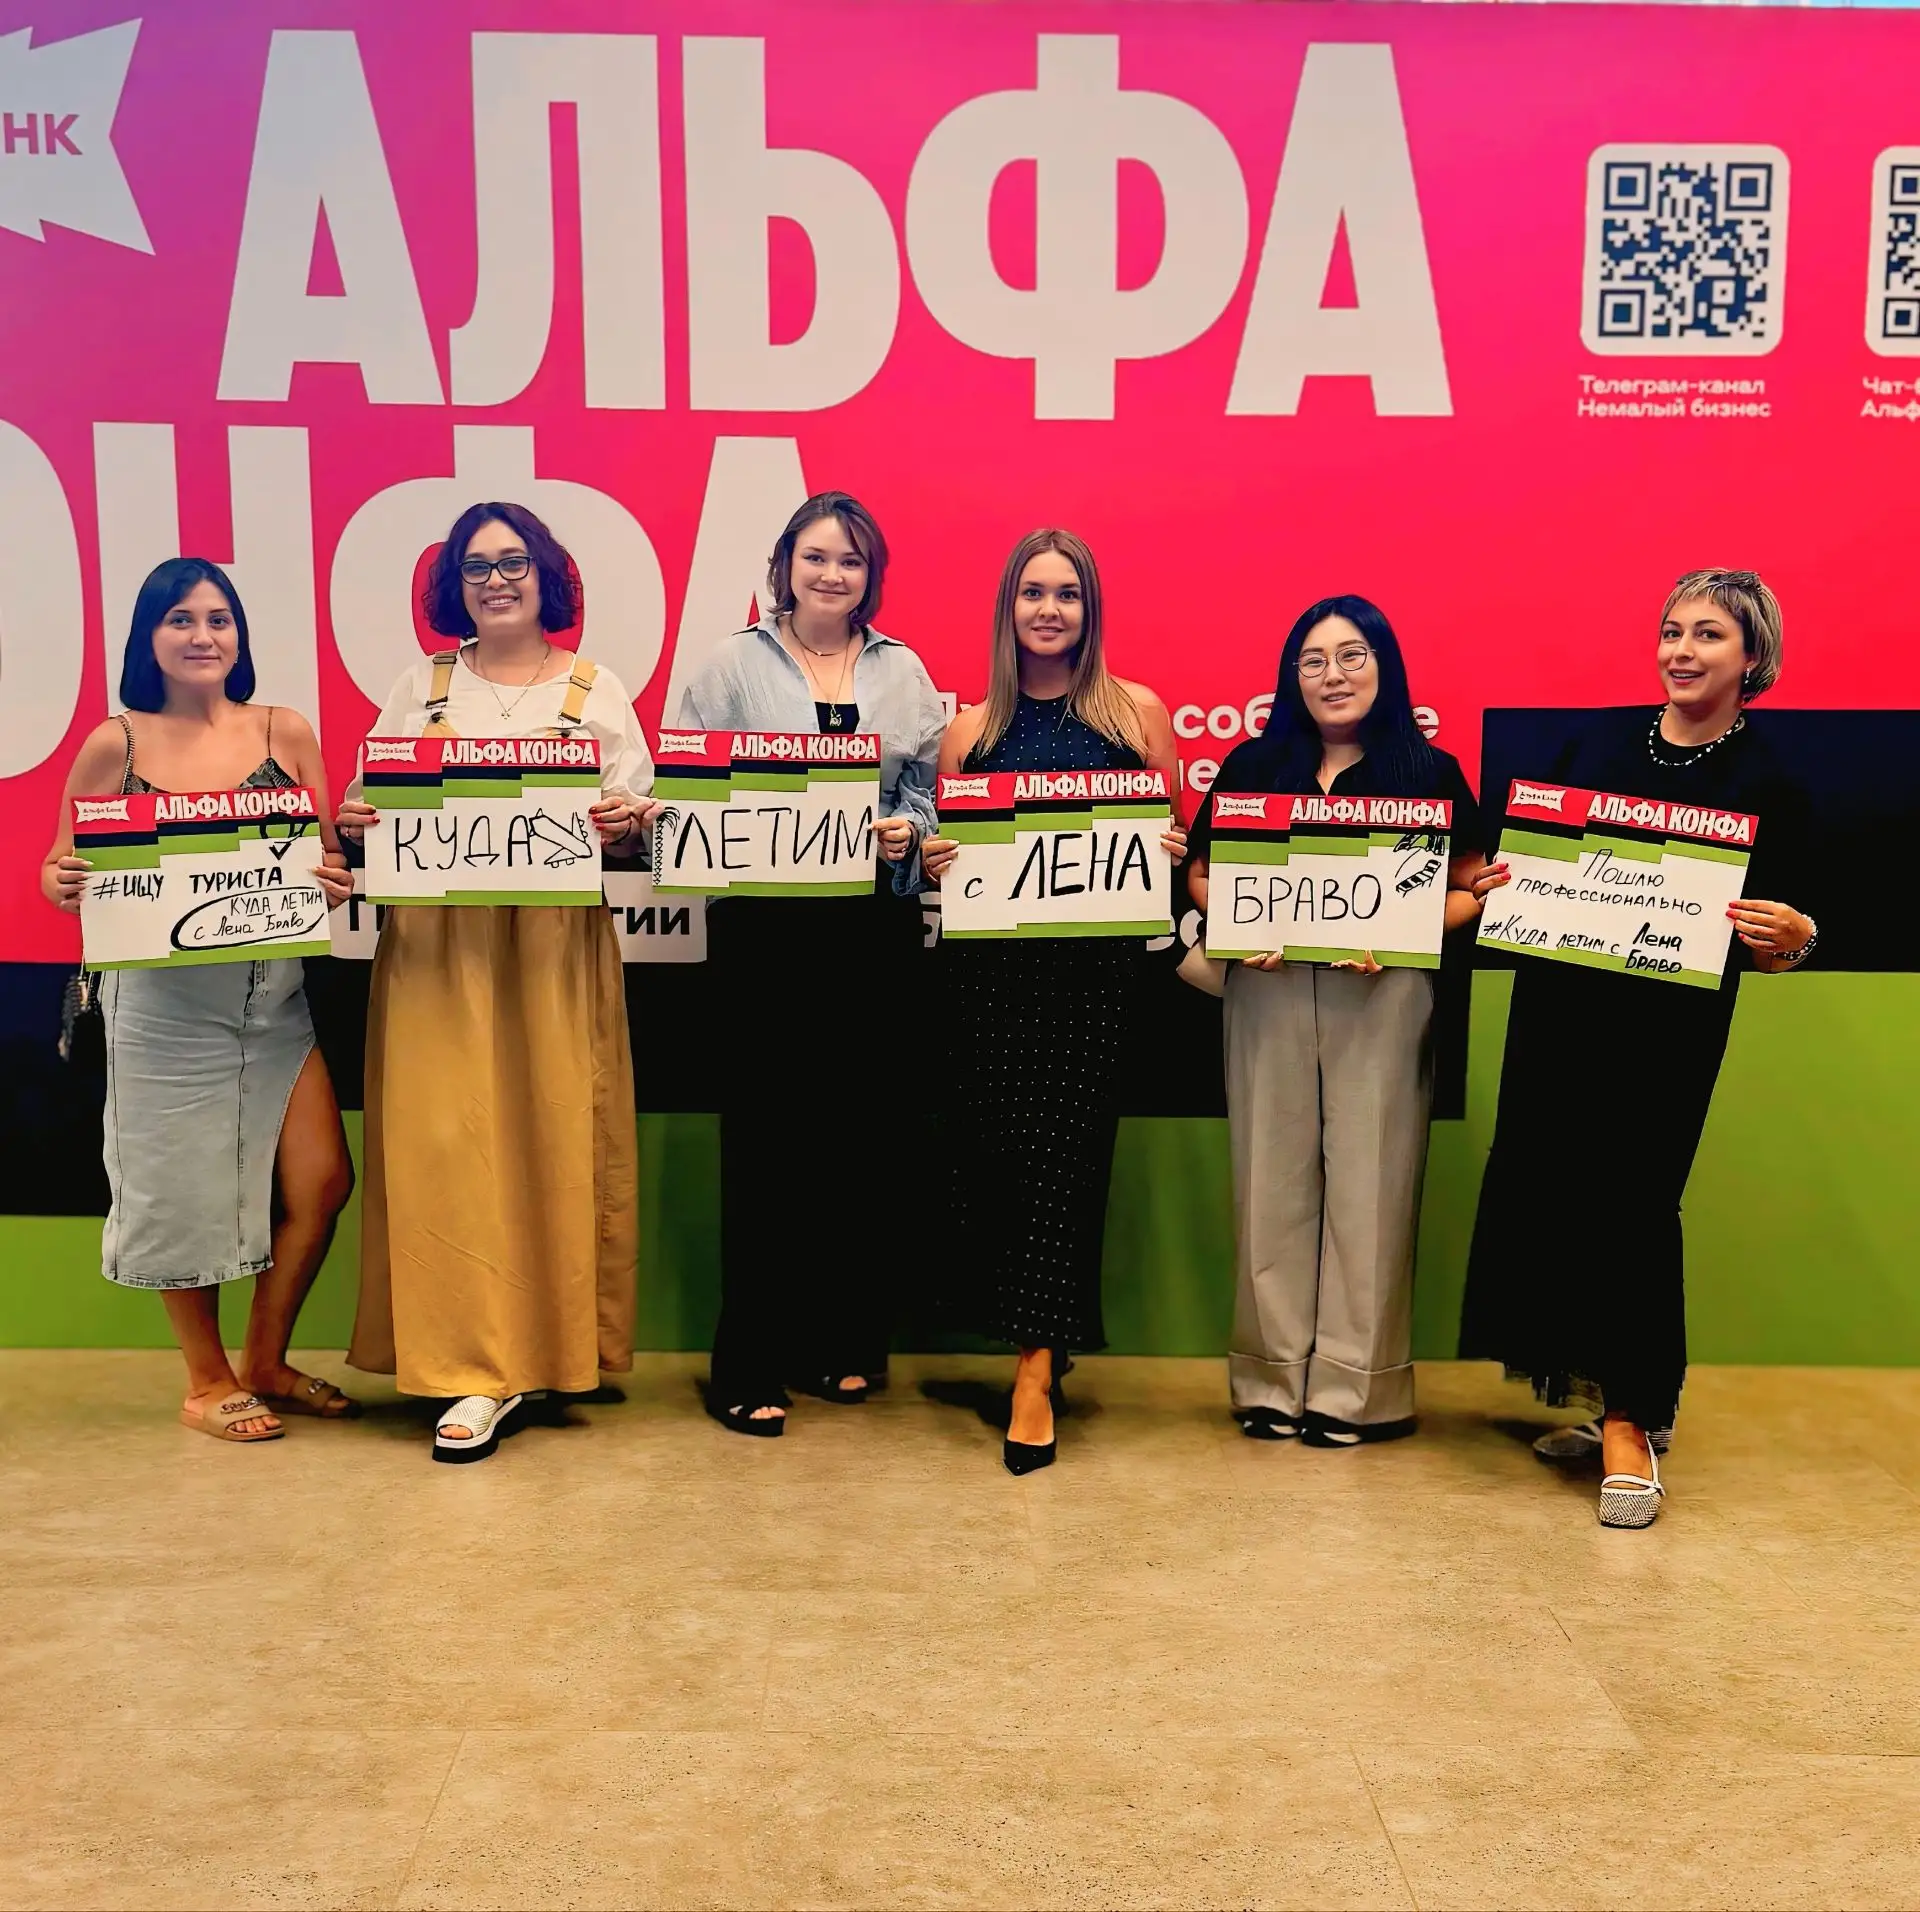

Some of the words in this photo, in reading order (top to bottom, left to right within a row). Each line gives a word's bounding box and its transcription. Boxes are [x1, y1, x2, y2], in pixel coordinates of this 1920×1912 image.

[216, 29, 1454, 421] АЛЬФА
[1577, 374, 1766, 398] Телеграм-канал
[1577, 398, 1686, 417] Немалый
[1690, 398, 1772, 417] бизнес
[441, 739, 517, 764] АЛЬФА
[519, 739, 596, 765] КОНФА
[731, 735, 804, 758] АЛЬФА
[806, 737, 878, 759] КОНФА
[1013, 775, 1088, 799] АЛЬФА
[1090, 772, 1166, 797] КОНФА
[155, 795, 233, 821] АЛЬФА
[233, 789, 314, 819] КОНФА
[1289, 797, 1367, 823] АЛЬФА
[1369, 799, 1447, 826] КОНФА
[1587, 794, 1669, 829] АЛЬФА
[1667, 805, 1750, 843] КОНФА
[395, 814, 533, 872] КУДА
[675, 805, 872, 869] ЛЕТИМ
[1008, 832, 1152, 900] ЛЕНА
[1583, 848, 1665, 887] Пошлю
[92, 874, 164, 901] #ИЩУ
[189, 866, 283, 894] ТУРИСТА
[1233, 873, 1382, 924] БРАВО
[230, 896, 271, 917] КУДА
[1632, 922, 1683, 953] Лена
